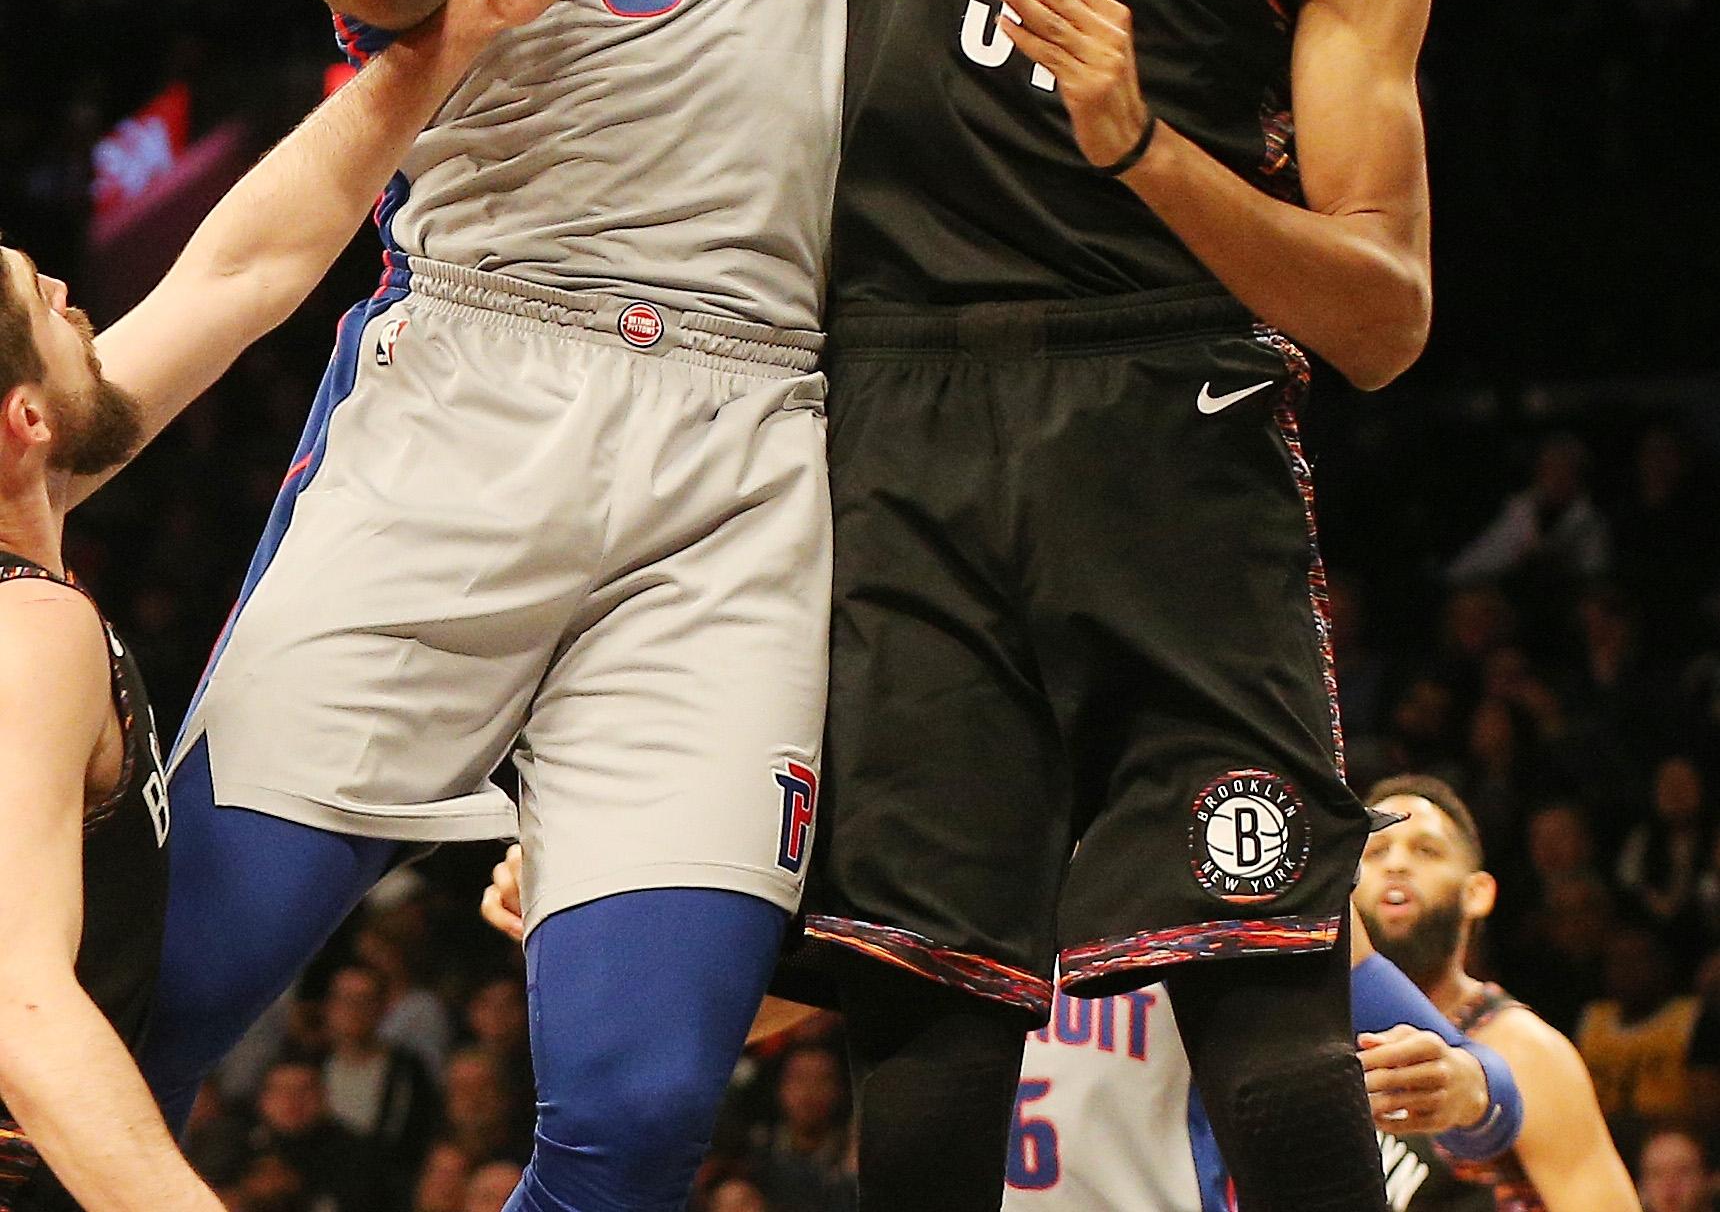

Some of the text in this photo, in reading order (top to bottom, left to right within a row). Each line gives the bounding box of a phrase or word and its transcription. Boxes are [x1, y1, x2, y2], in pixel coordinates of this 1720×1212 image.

[1197, 779, 1297, 823] BROOKLYN
[1234, 807, 1262, 868] B
[1200, 856, 1297, 893] NEW YORK
[1027, 987, 1156, 1062] OIT
[1006, 1077, 1063, 1192] 6
